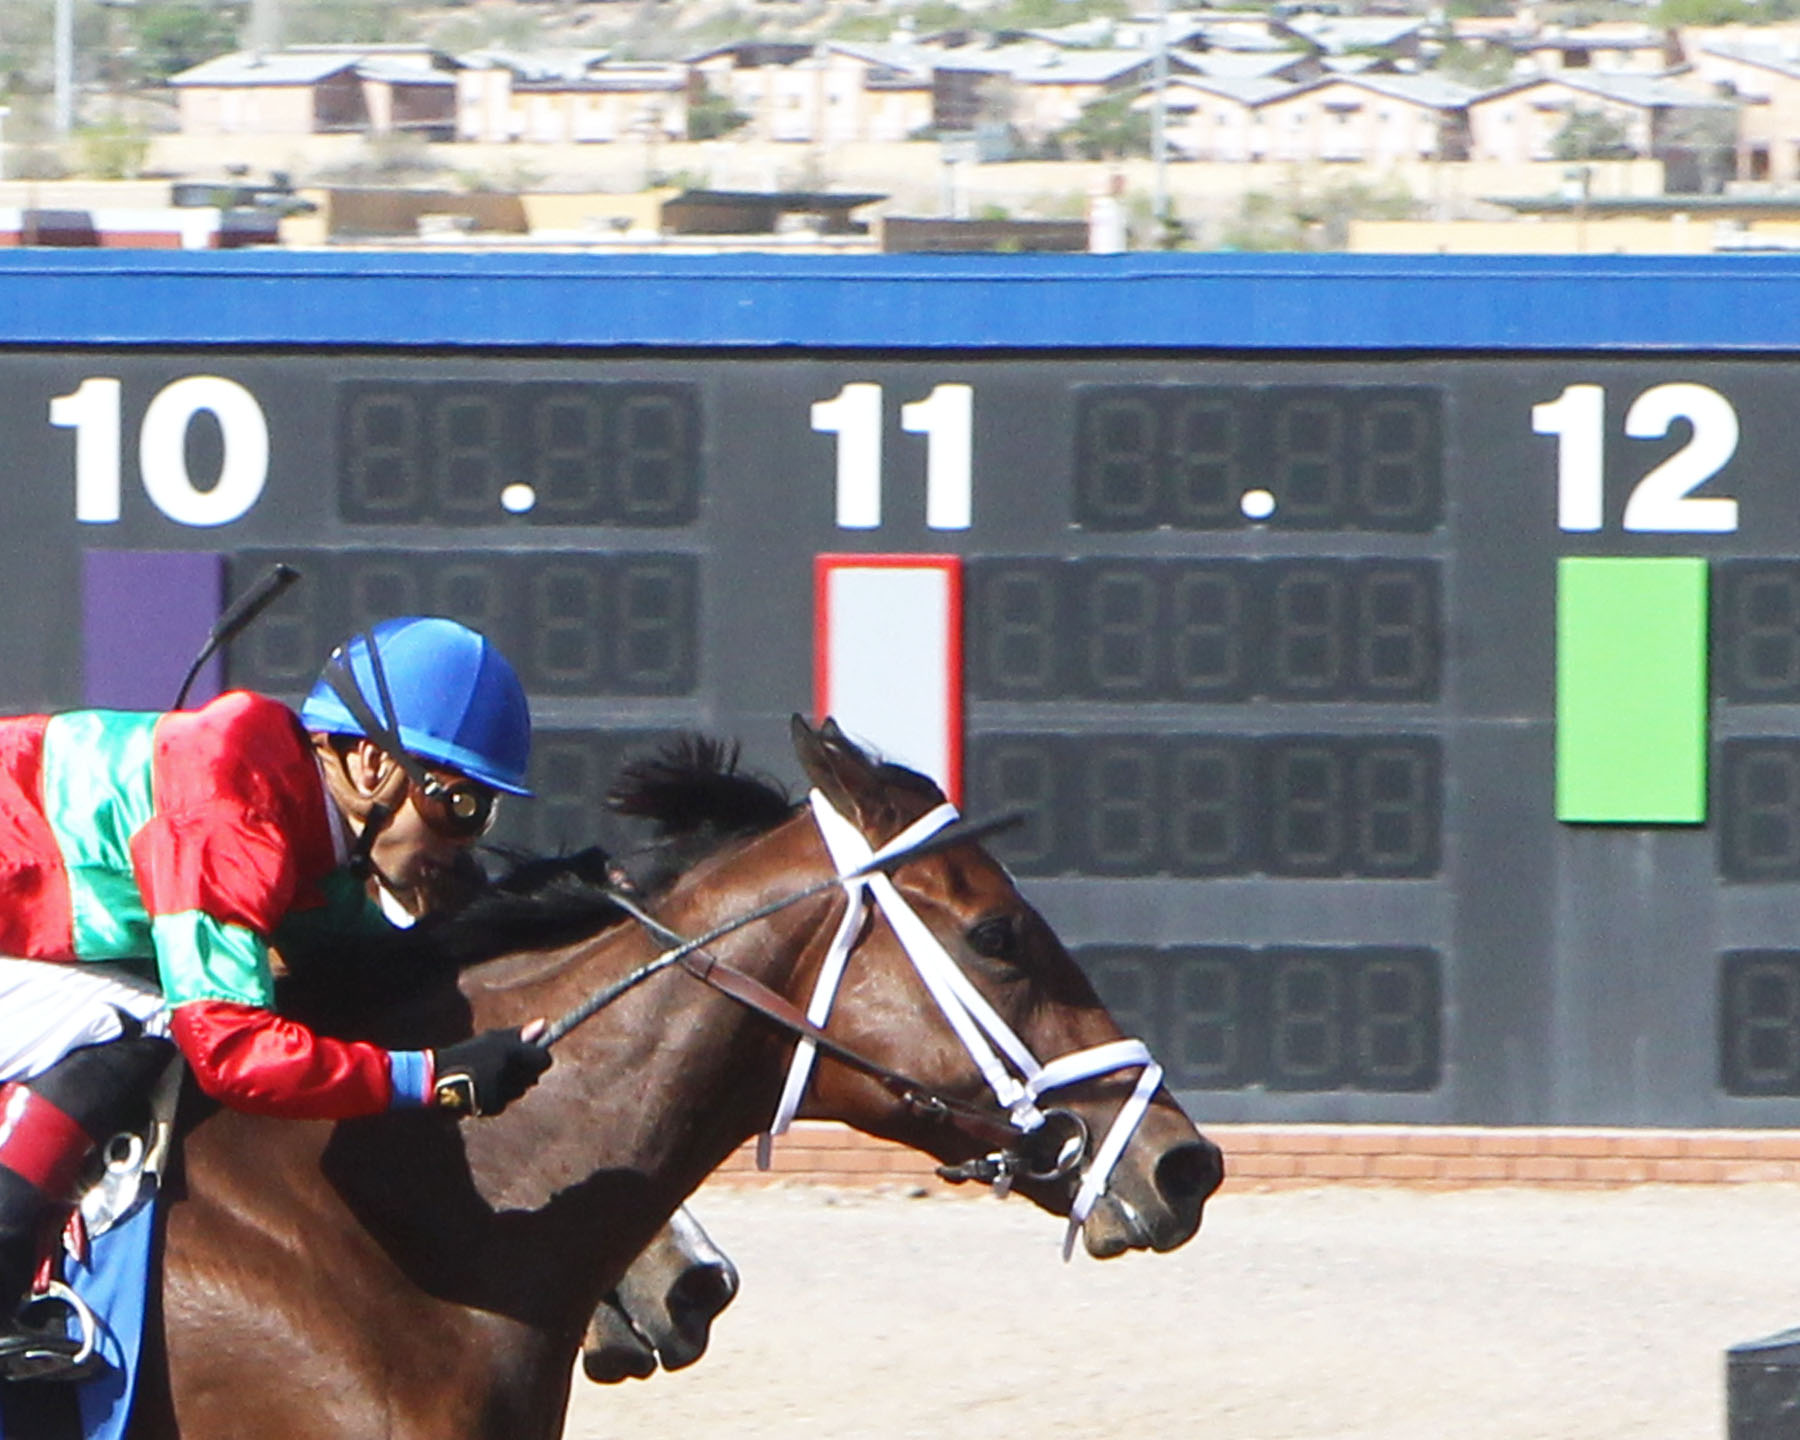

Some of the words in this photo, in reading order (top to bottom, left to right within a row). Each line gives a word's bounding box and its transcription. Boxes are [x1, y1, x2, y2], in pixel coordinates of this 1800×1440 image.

[49, 376, 270, 527] 10
[810, 383, 974, 530] 11
[1531, 383, 1740, 533] 12
